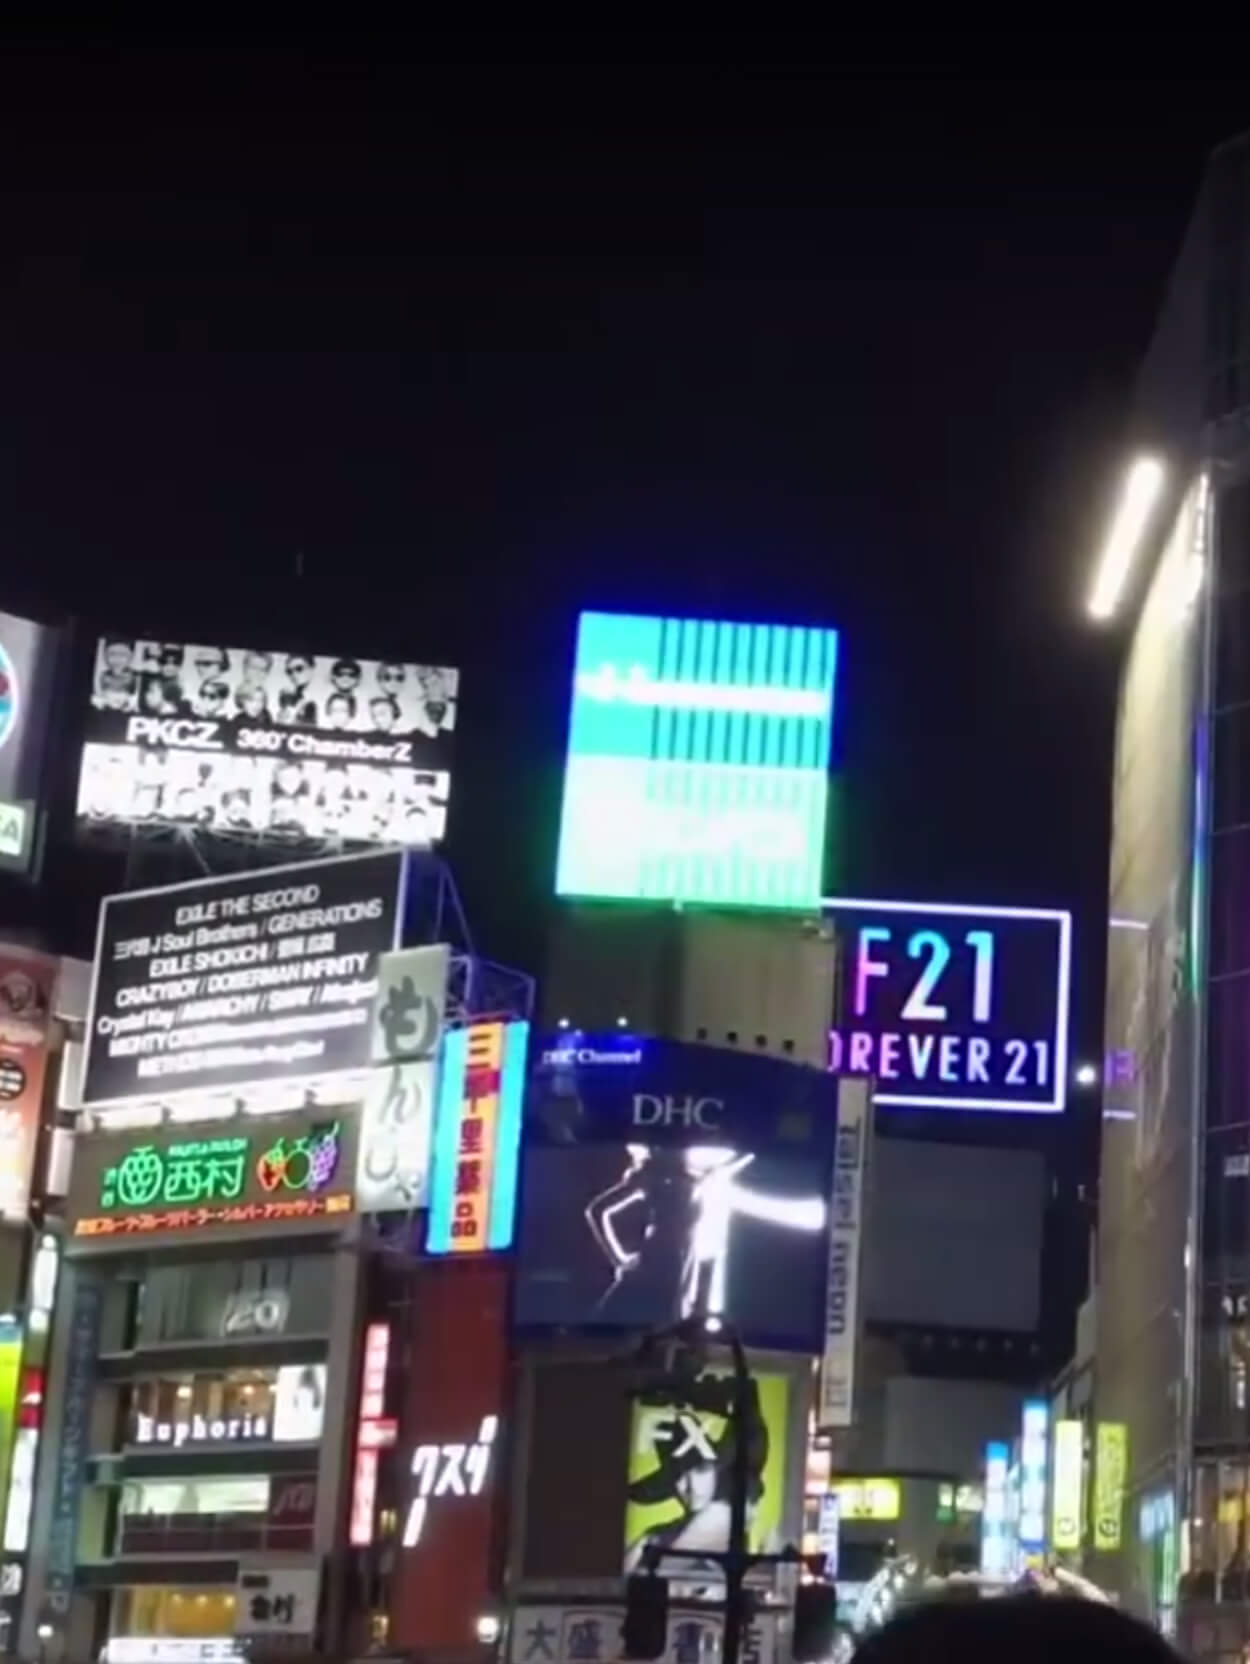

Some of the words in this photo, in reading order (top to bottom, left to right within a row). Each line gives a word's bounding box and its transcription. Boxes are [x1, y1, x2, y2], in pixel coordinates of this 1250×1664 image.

[221, 895, 250, 919] THE
[251, 884, 320, 911] SECOND
[855, 927, 994, 1023] F21
[1004, 1039, 1049, 1087] 21
[632, 1093, 724, 1130] DHC
[632, 1404, 718, 1461] FX
